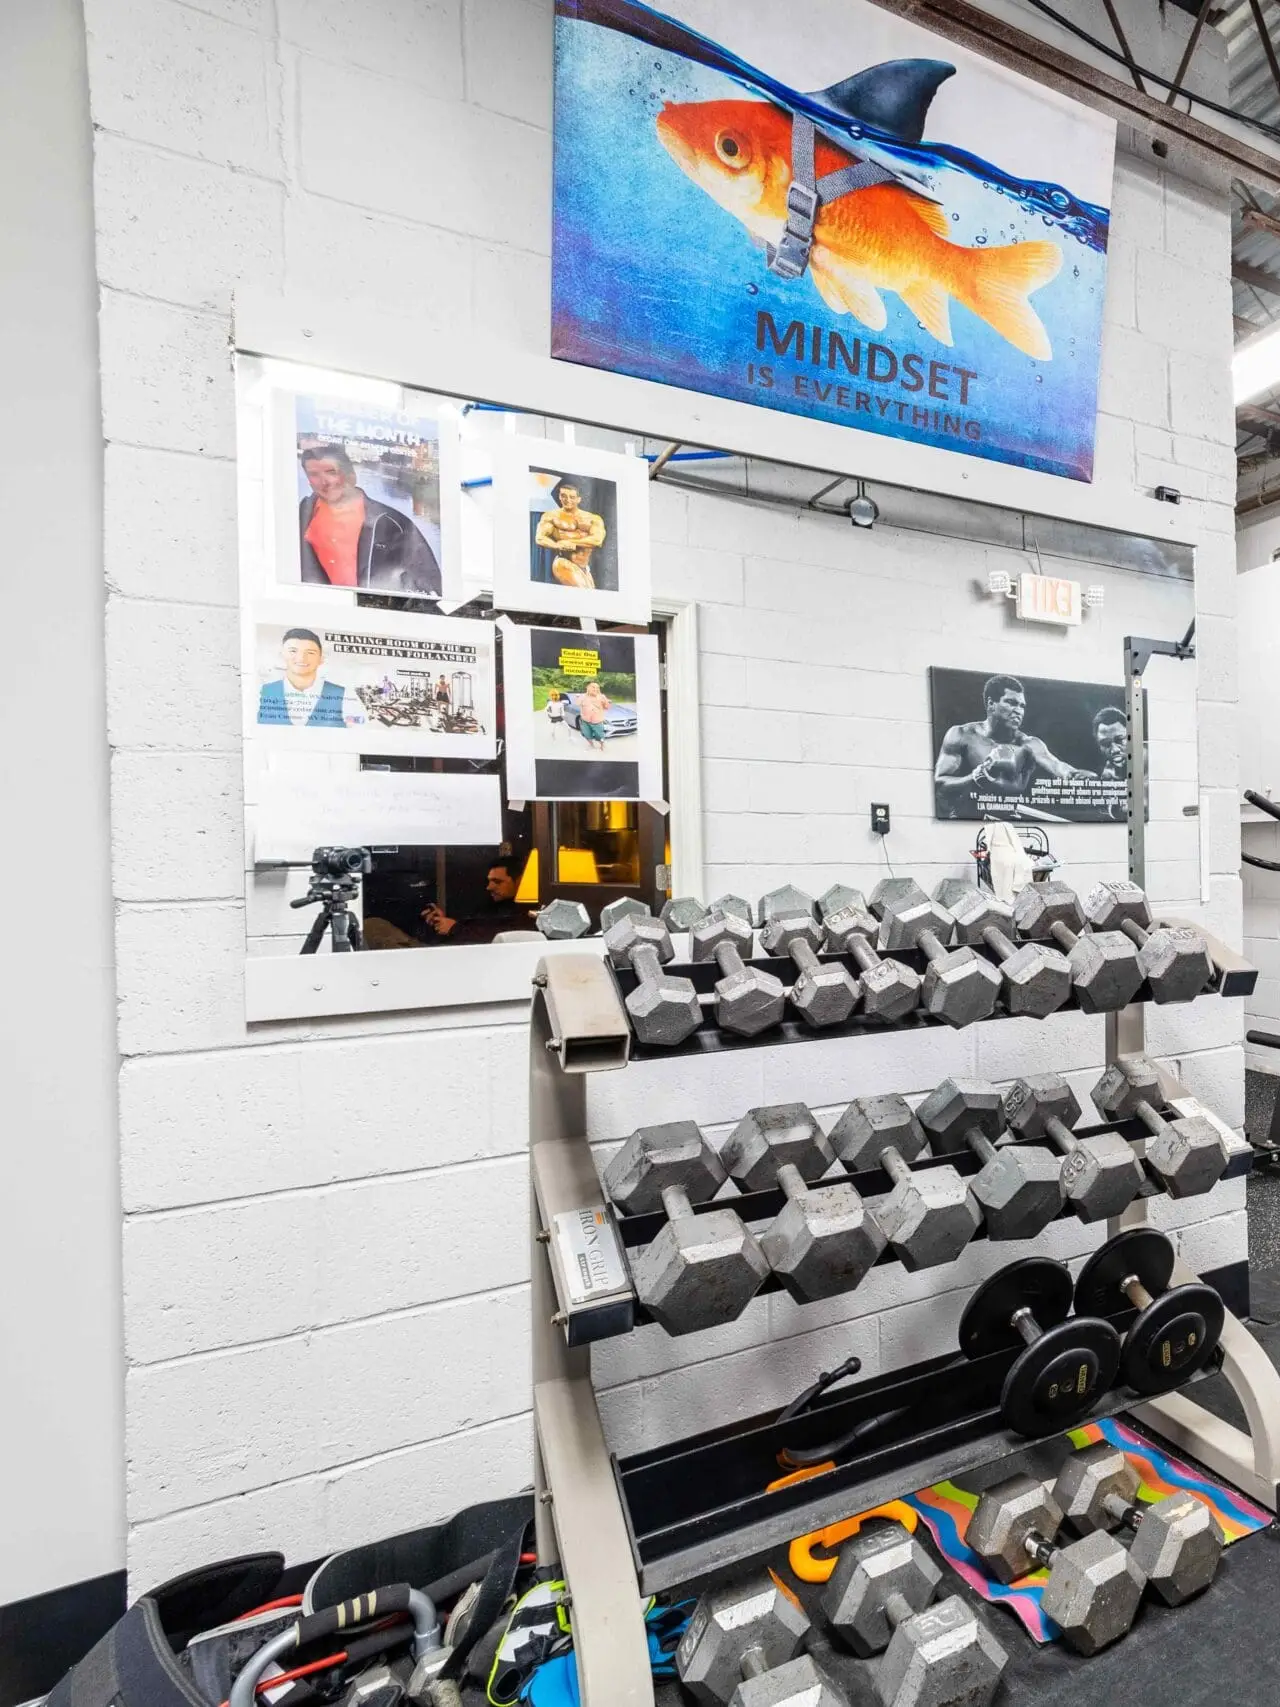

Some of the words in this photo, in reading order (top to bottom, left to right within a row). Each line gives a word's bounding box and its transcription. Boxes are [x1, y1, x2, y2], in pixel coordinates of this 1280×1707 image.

[756, 311, 978, 405] MINDSET
[747, 363, 774, 388] IS
[795, 376, 982, 441] EVERYTHING
[317, 414, 351, 432] THE
[356, 419, 421, 447] MONTH
[325, 633, 383, 645] TRAINING
[386, 639, 419, 648] ROOM
[422, 642, 436, 650] OF
[439, 644, 461, 652] THE
[334, 644, 388, 656] REALTOR
[406, 651, 476, 663] FOLLANSBEE
[1004, 1086, 1026, 1114] 35
[1064, 1153, 1086, 1188] 35
[579, 1209, 598, 1246] IRON
[588, 1247, 609, 1286] GRIP
[917, 1607, 963, 1636] 50
